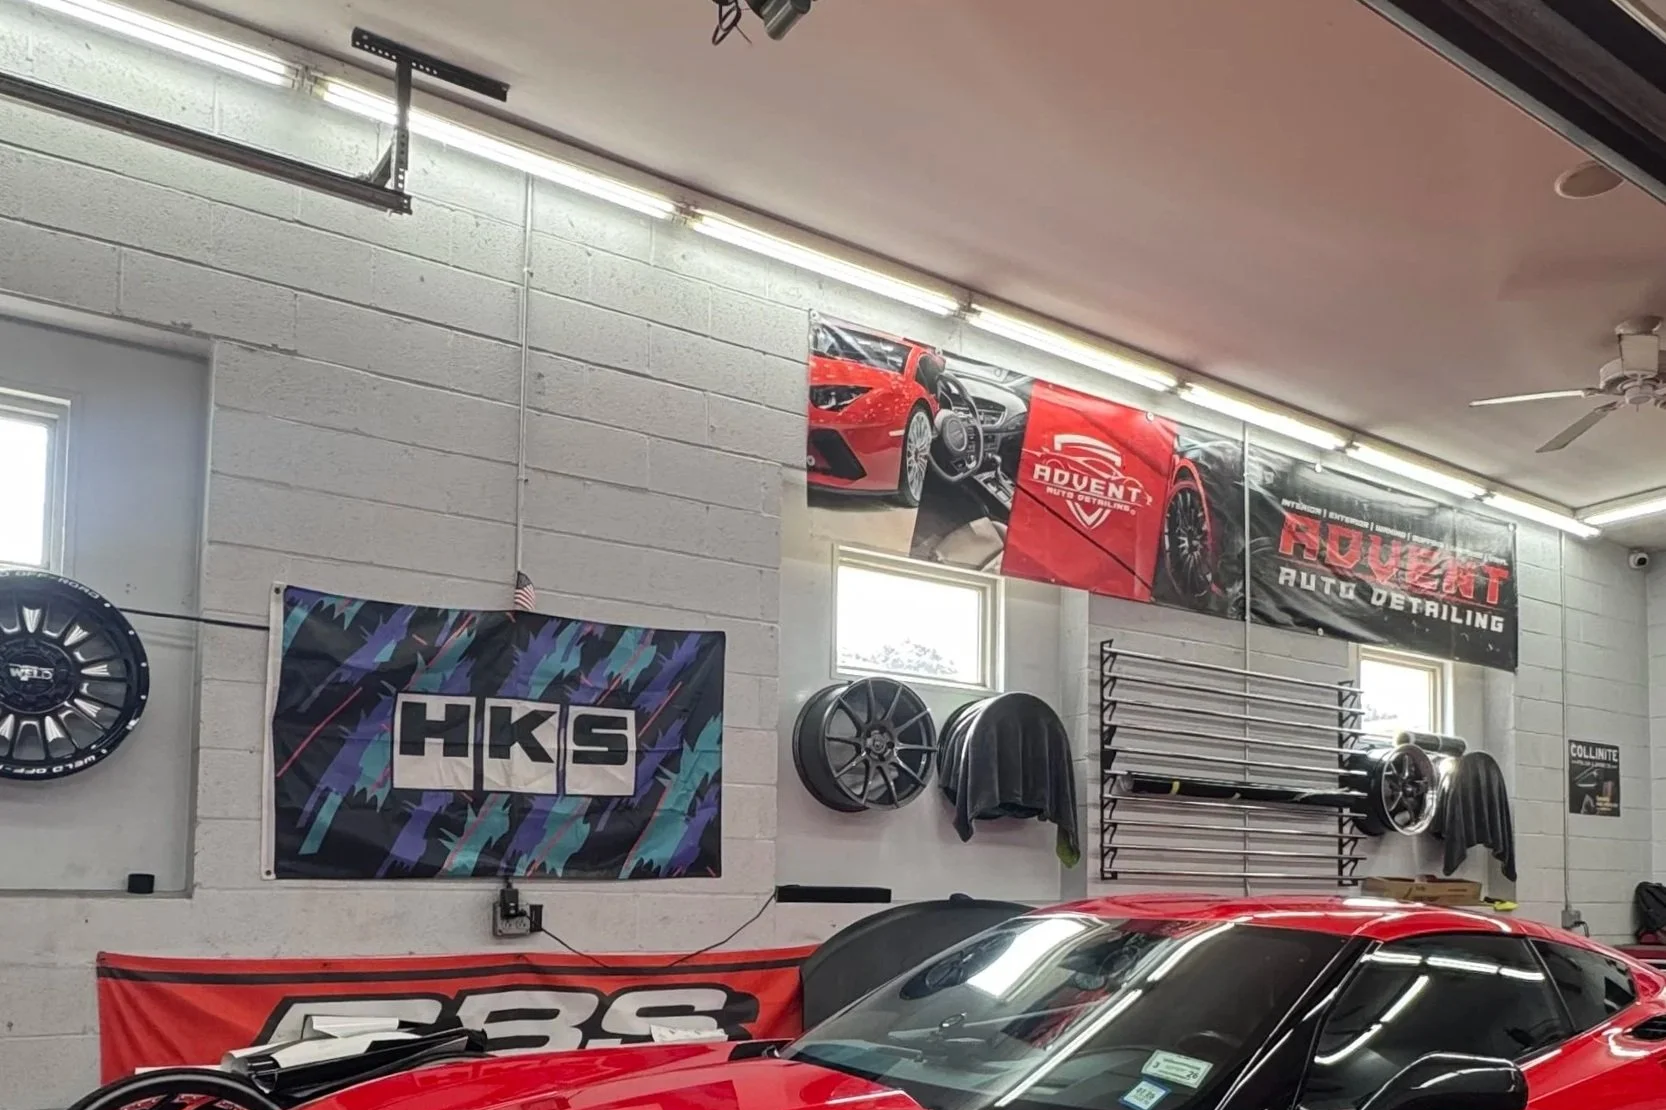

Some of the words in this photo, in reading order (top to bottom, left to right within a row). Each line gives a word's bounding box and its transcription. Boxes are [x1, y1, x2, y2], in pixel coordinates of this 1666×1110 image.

[1032, 463, 1142, 503] ADVENT
[1046, 486, 1074, 499] AUTO
[1077, 494, 1131, 512] DETAILING
[1281, 498, 1323, 515] INTERIOR
[1328, 511, 1370, 529] EXTERIOR
[1278, 512, 1509, 604] ADVENT
[1278, 566, 1357, 600] AUTO
[1370, 587, 1504, 633] DETAILING
[9, 667, 53, 681] WELD
[399, 700, 628, 766] HKS
[1570, 742, 1619, 762] COLLINITE
